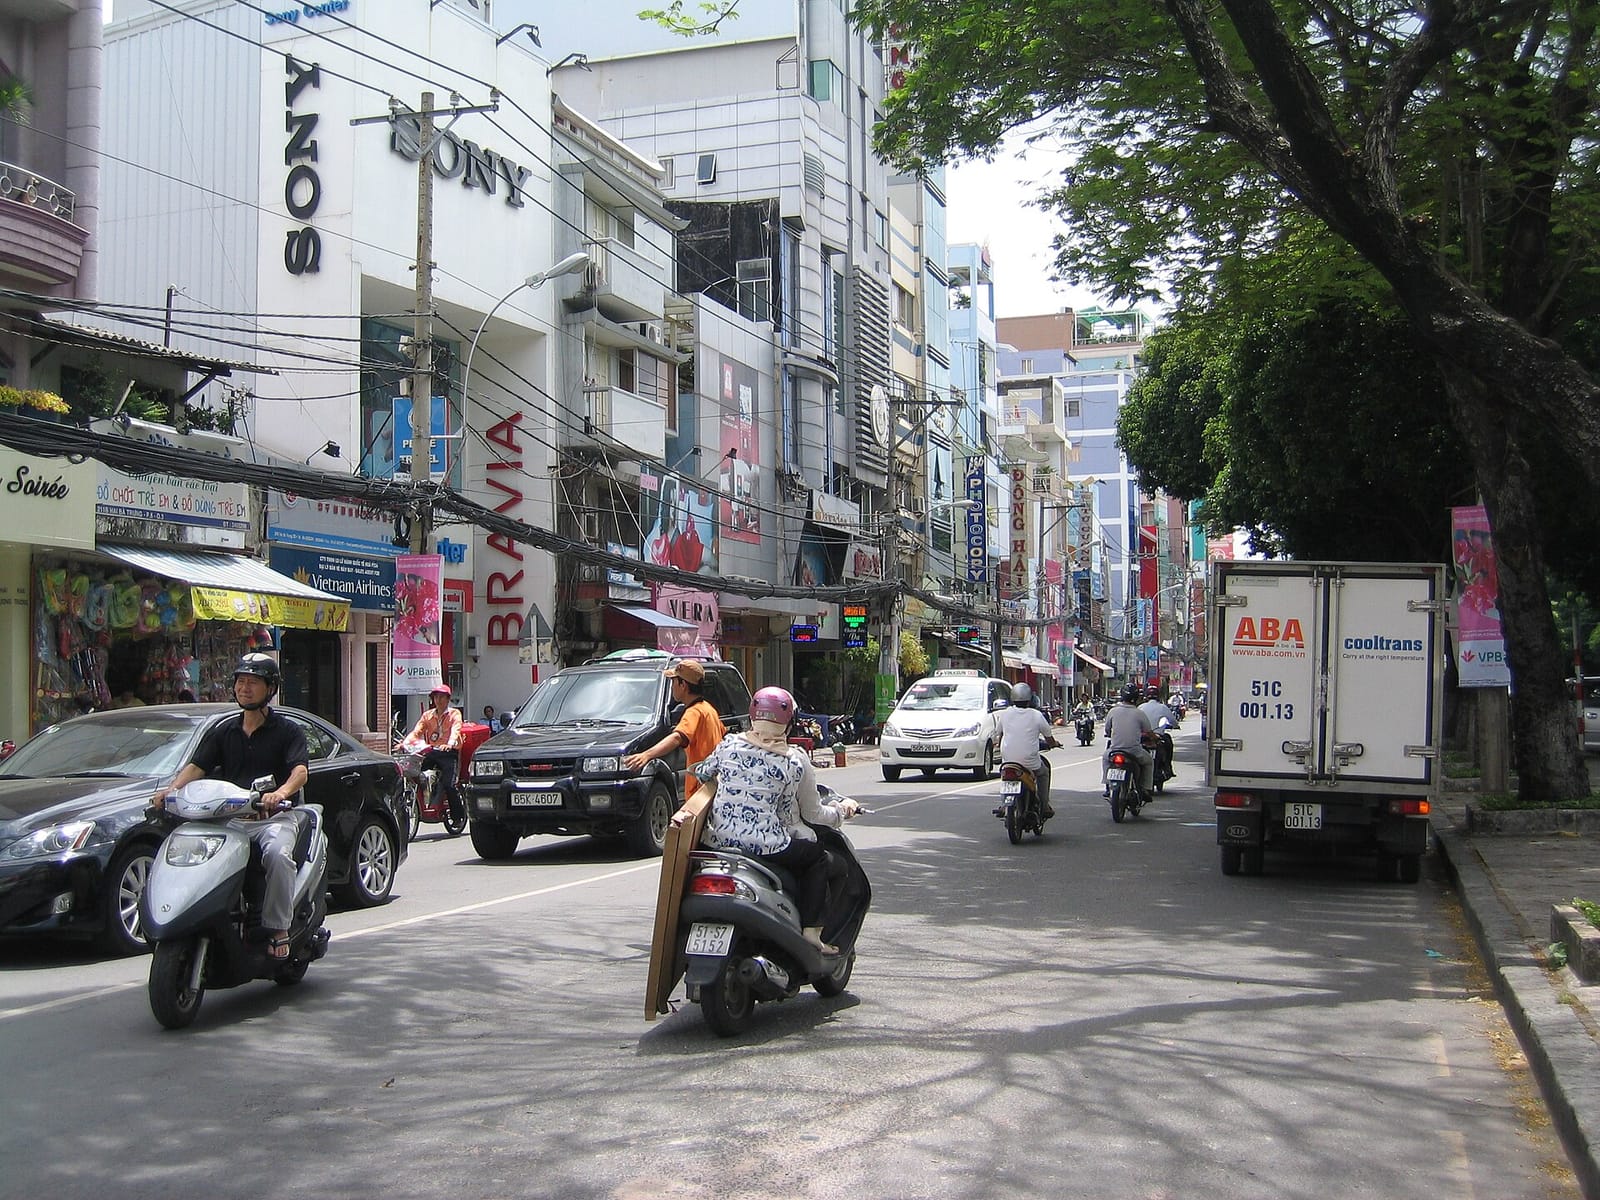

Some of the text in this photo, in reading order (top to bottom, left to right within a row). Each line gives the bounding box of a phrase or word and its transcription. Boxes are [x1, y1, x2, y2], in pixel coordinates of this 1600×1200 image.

[264, 0, 350, 25] Sony Center
[284, 53, 320, 275] SONY
[389, 107, 532, 209] SONY
[7, 465, 70, 500] Soirée
[159, 493, 170, 508] EM
[172, 494, 179, 509] &
[237, 503, 247, 517] EM
[486, 411, 524, 646] BRAVIA
[970, 478, 984, 581] PHOTOCOPY
[311, 573, 391, 597] Vietnam Airlines
[668, 599, 715, 622] VERA
[1234, 616, 1304, 642] ABA
[1232, 649, 1305, 658] www.aba.com.vn
[1344, 635, 1423, 651] cooltrans
[407, 667, 441, 676] VPBank
[1251, 680, 1282, 697] 51C
[1240, 702, 1294, 720] 001.13
[1293, 804, 1313, 816] 51C
[1286, 816, 1321, 828] 001.13
[693, 939, 724, 953] 5152
